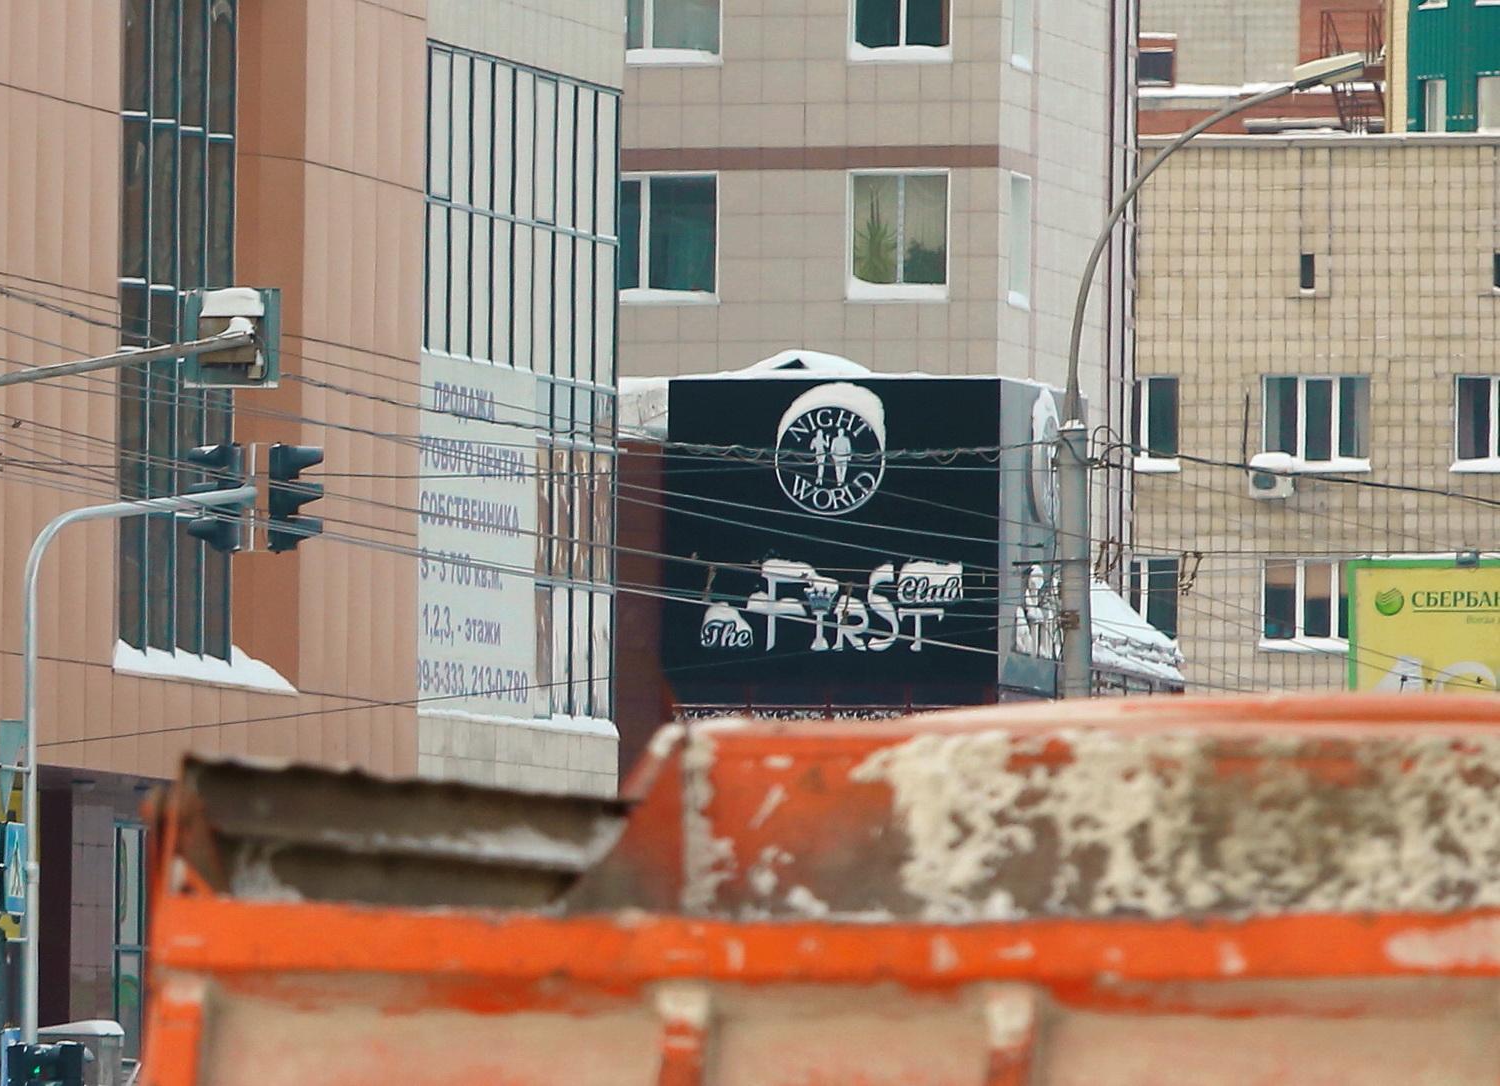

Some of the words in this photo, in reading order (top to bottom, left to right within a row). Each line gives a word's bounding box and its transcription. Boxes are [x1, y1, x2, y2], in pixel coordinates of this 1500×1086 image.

[433, 380, 495, 424] ПРОДАЖА
[788, 408, 873, 443] NIGHT
[476, 443, 526, 484] ЦЕНТРА
[791, 471, 876, 511] WORLD
[420, 490, 520, 538] СОБСТВЕННИКА
[423, 602, 454, 647] 1,2,3,
[465, 617, 501, 647] этажи
[700, 619, 754, 649] The
[898, 576, 963, 605] Club
[471, 664, 529, 704] 213-0-780
